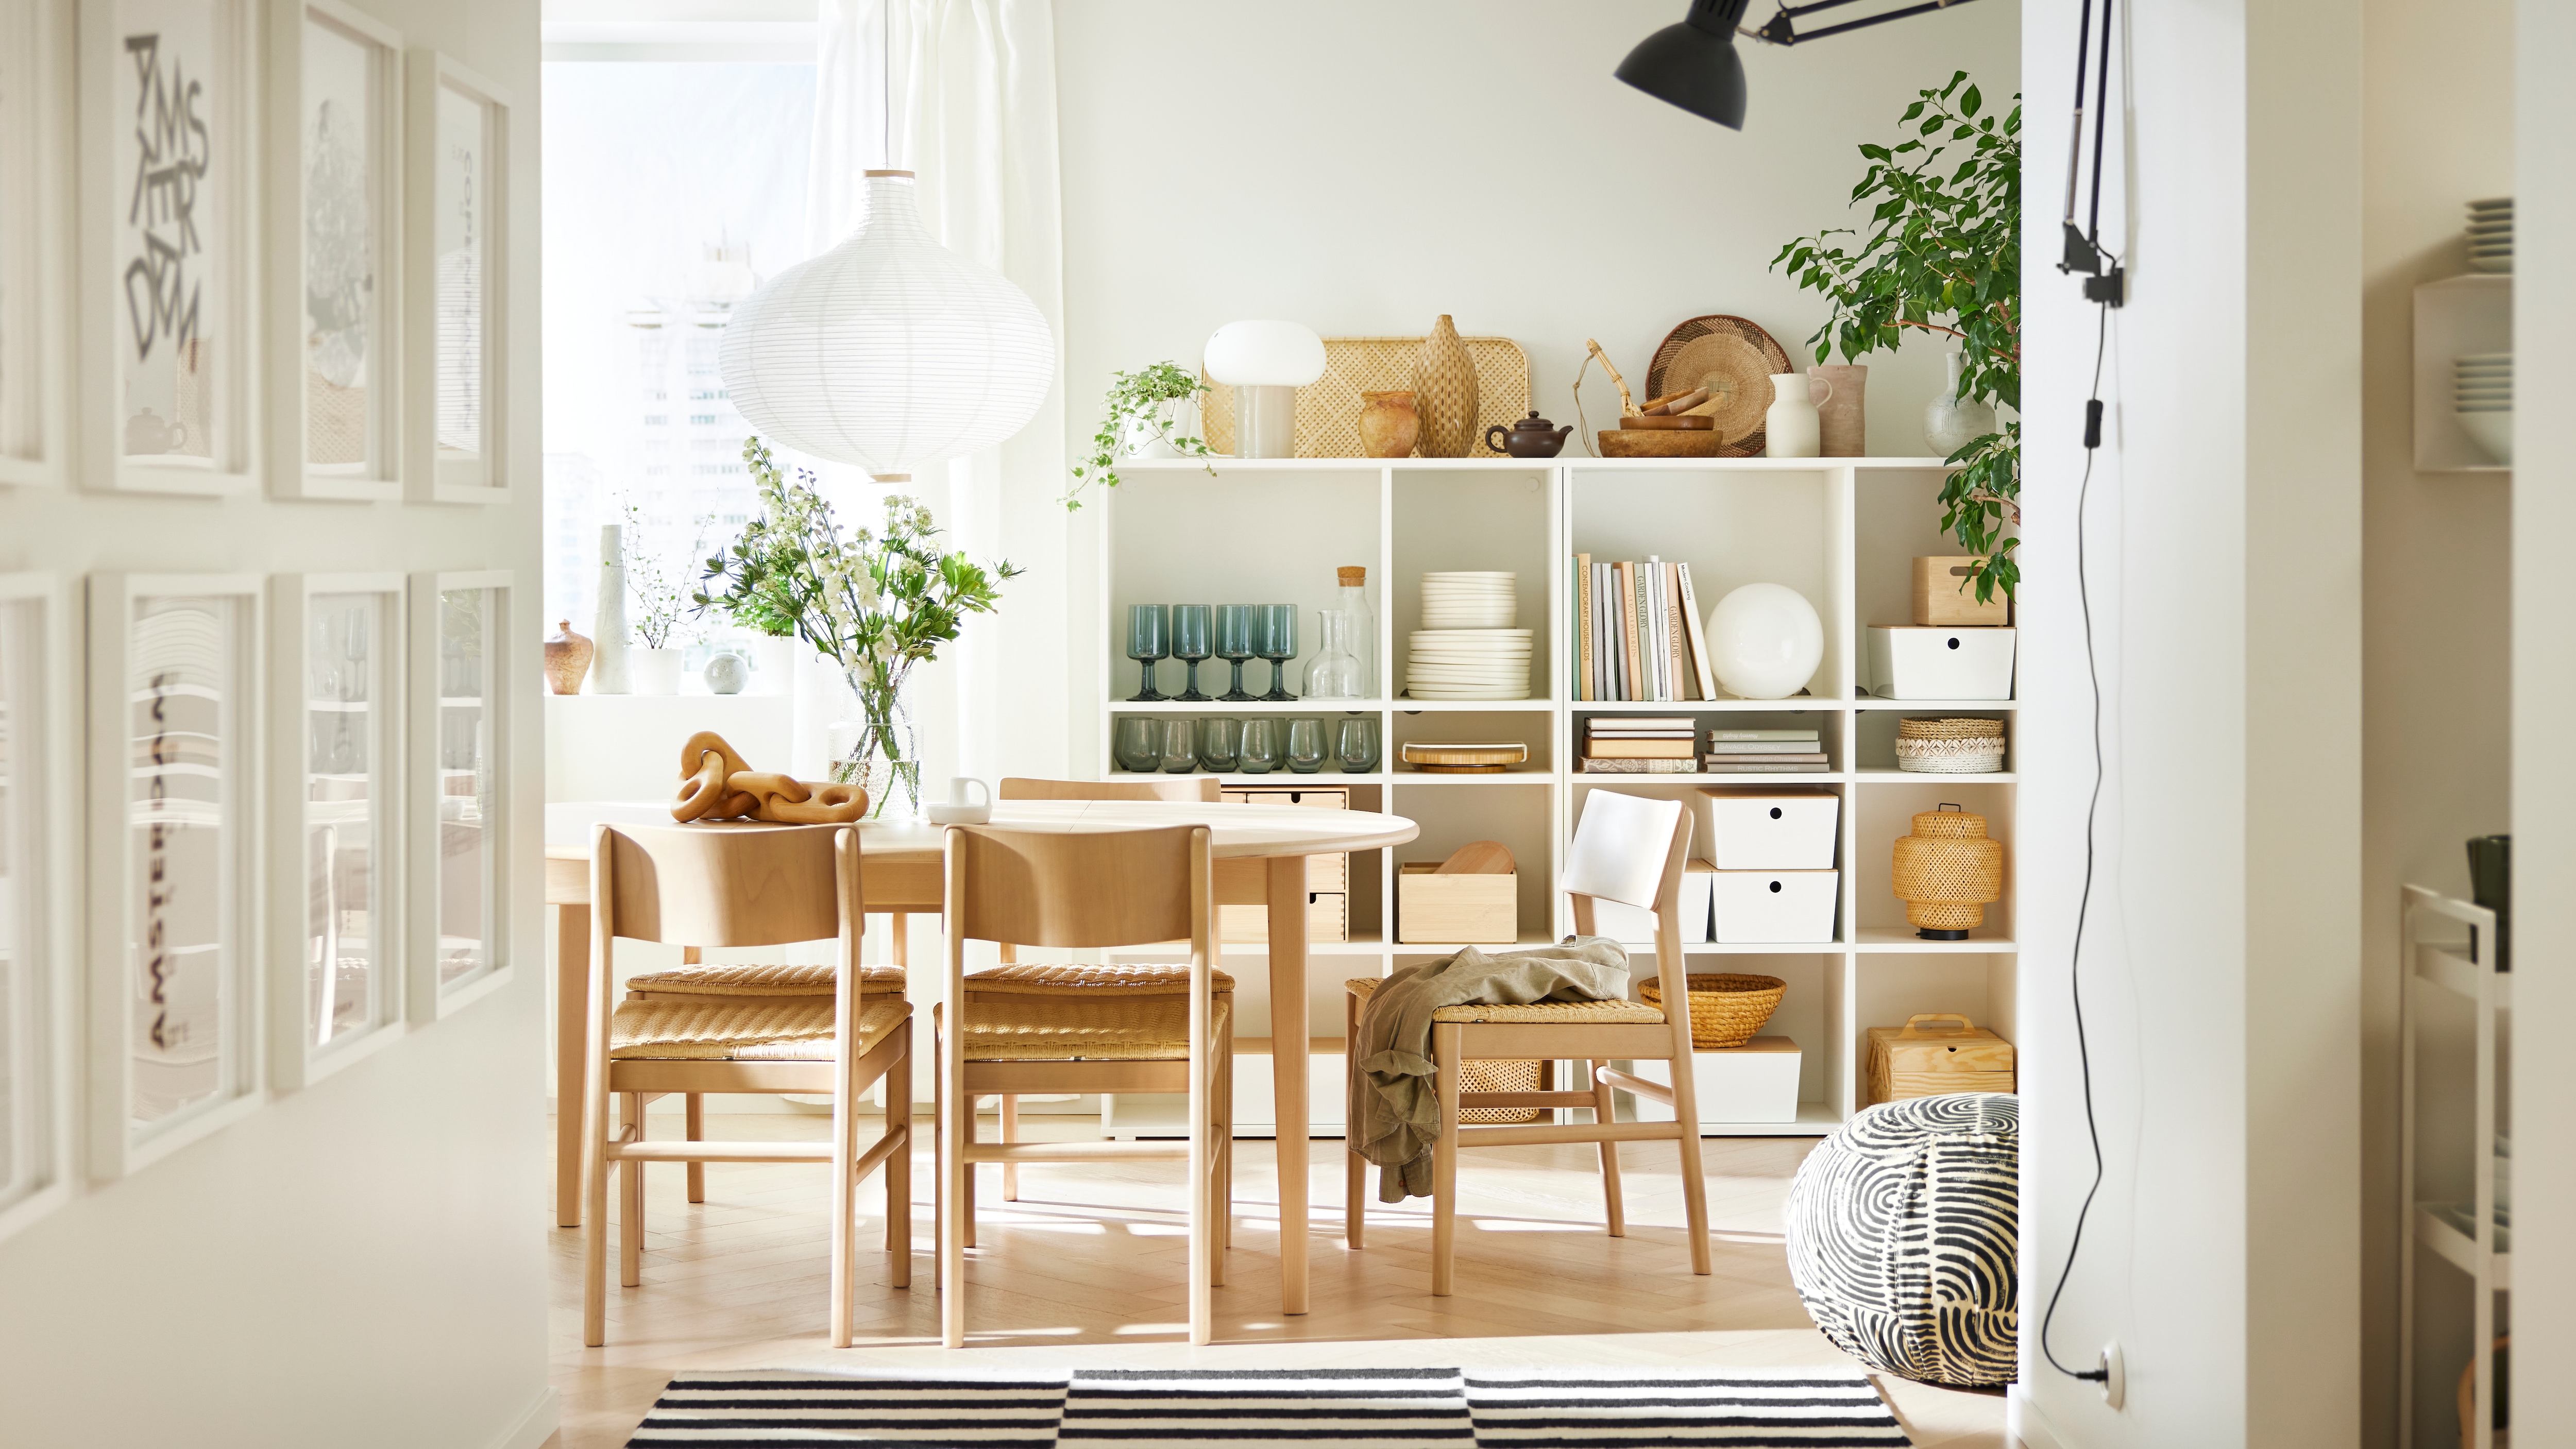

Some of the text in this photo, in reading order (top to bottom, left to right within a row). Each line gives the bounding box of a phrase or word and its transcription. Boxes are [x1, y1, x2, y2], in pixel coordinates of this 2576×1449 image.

[1637, 576, 1648, 628] GARDEN GLORY
[1670, 606, 1680, 659] GARDEN GLORY
